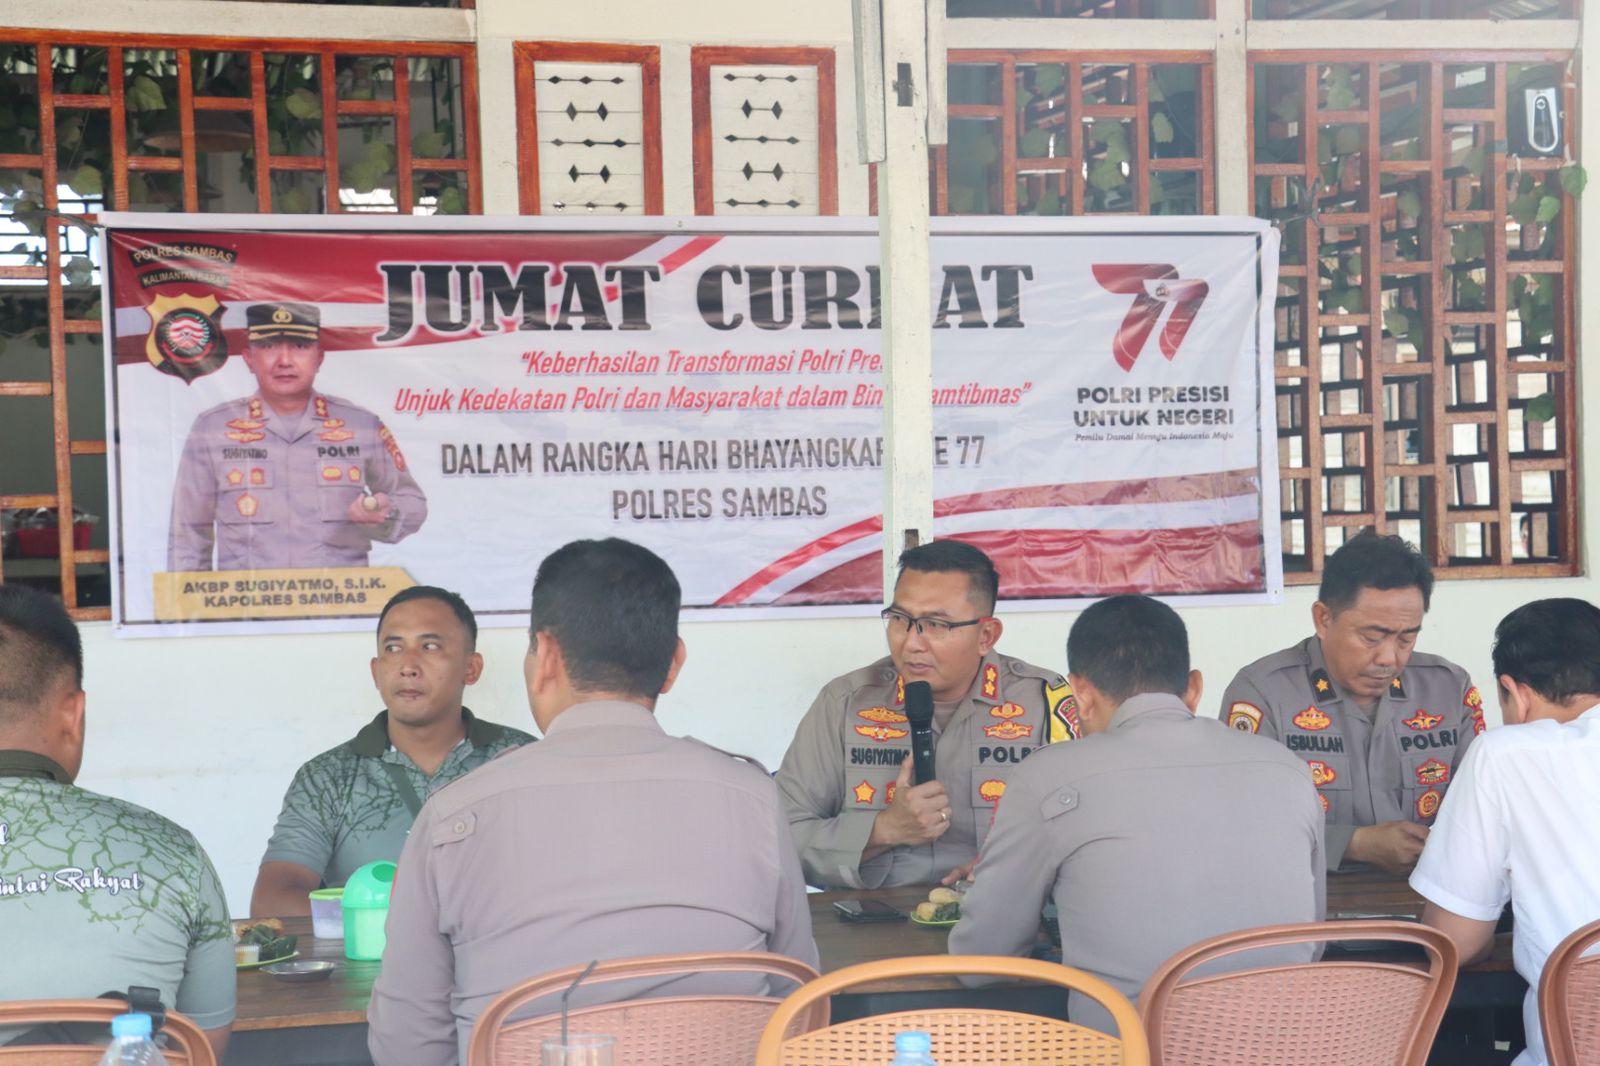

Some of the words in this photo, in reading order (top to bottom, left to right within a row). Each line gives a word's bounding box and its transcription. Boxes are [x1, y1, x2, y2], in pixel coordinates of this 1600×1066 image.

[133, 246, 180, 263] POLRES
[183, 246, 233, 263] SAMBAS
[375, 264, 661, 342] JUMAT
[696, 264, 1034, 330] CURAT
[1091, 263, 1210, 374] 77
[665, 349, 794, 374] Transformasi
[797, 348, 846, 373] Polri
[394, 388, 451, 417] Unjuk
[457, 387, 568, 412] Kedekatan
[572, 386, 621, 411] Polri
[623, 386, 662, 410] dan
[665, 385, 783, 415] Masyarakat
[787, 384, 849, 409] dalam
[852, 384, 884, 407] Bin
[931, 382, 1033, 405] amtibmas”
[1077, 387, 1142, 404] POLRI
[1148, 386, 1230, 403] PRESISI
[1073, 409, 1150, 428] UNTUK
[1157, 408, 1235, 426] NEGERI
[316, 445, 361, 458] POLRI
[440, 442, 534, 474] DALAM
[542, 441, 650, 473] RANGKA
[658, 440, 718, 471] HARI
[727, 437, 884, 469] BHAYANGKA
[932, 436, 949, 466] E
[956, 436, 985, 465] 77
[612, 489, 713, 520] POLRES
[721, 486, 828, 518] SAMBAS
[183, 581, 230, 594] AKBP
[234, 579, 339, 593] SUGIYATMO,
[343, 577, 387, 590] S.I.K.
[204, 594, 294, 608] KAPOLRES
[298, 592, 367, 605] SAMBAS
[1286, 734, 1344, 753] ISBULLAH
[1400, 728, 1458, 752] POLRI
[978, 746, 1036, 764] POLR
[53, 866, 144, 896] Rakyat
